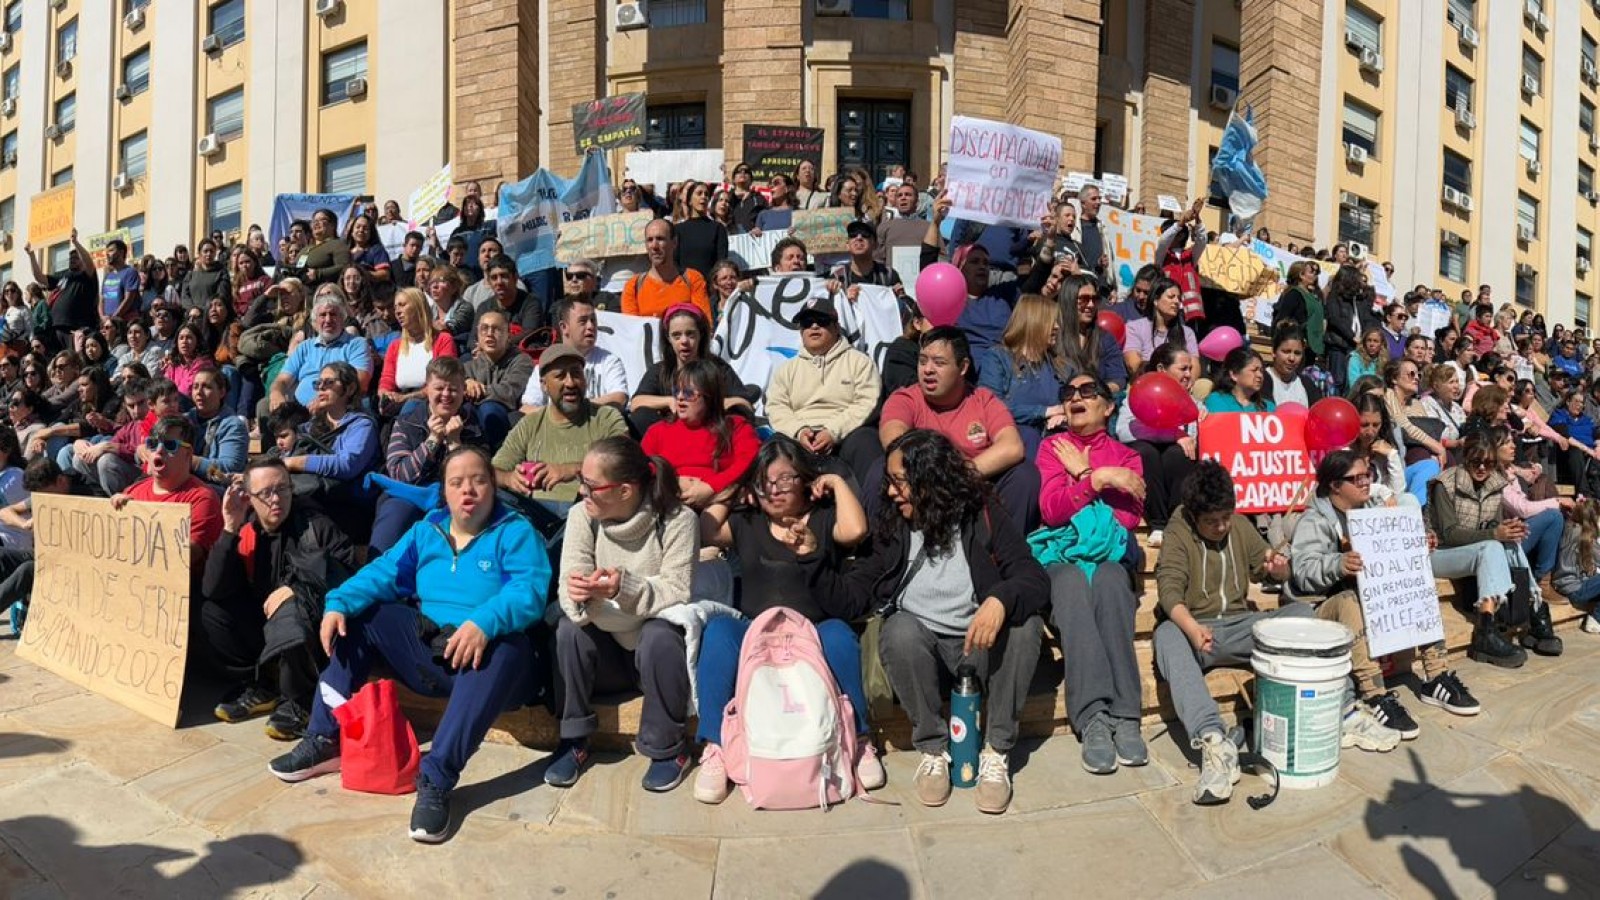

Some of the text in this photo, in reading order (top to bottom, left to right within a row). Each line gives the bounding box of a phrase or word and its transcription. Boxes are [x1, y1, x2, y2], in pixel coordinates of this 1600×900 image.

[950, 125, 1059, 172] DISCAPACIDAD
[1240, 414, 1284, 444] NO
[1230, 451, 1306, 477] AJUSTE
[1372, 538, 1399, 553] DICE
[1363, 561, 1384, 579] NO
[1389, 558, 1404, 574] AL
[1362, 584, 1380, 601] SIN
[125, 575, 190, 648] SERIE
[778, 684, 807, 714] L
